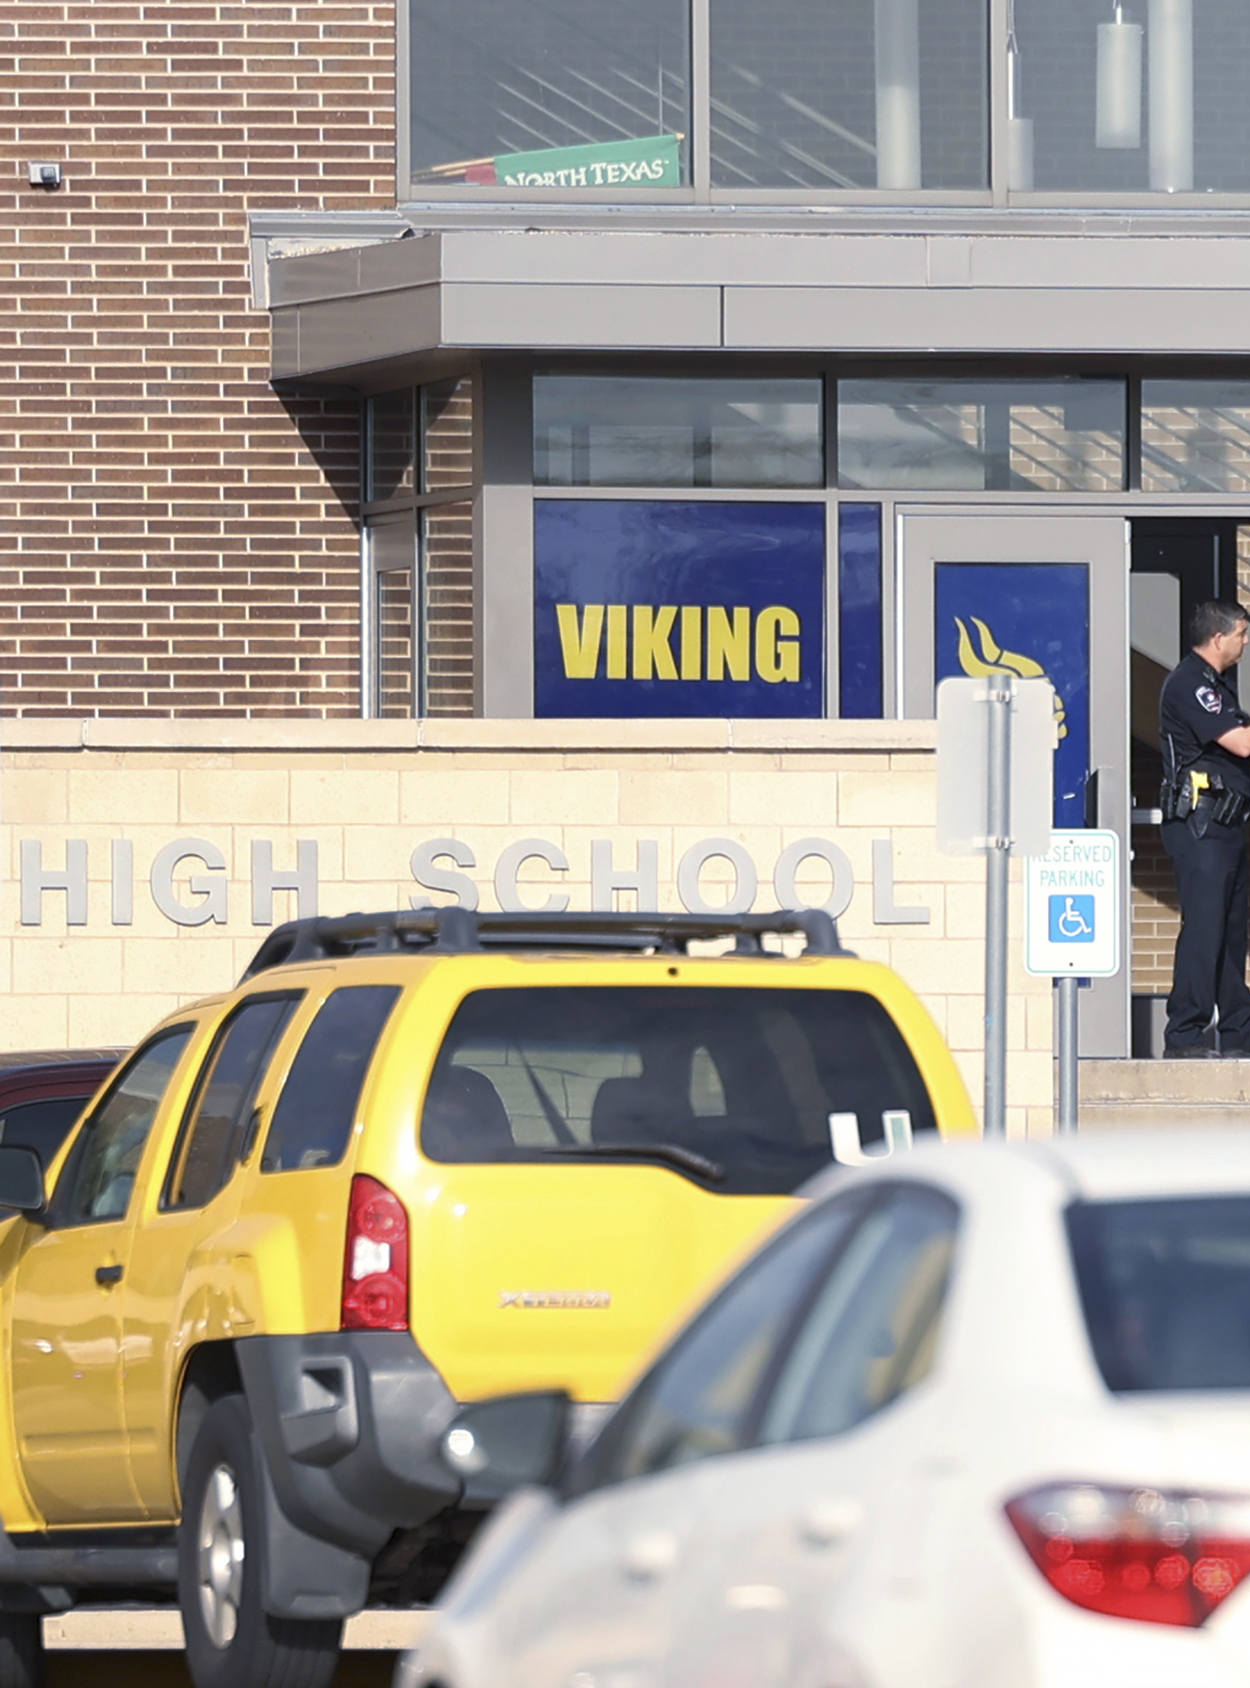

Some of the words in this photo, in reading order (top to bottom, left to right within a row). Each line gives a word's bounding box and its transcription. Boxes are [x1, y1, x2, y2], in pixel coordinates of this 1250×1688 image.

[505, 168, 587, 186] NORTH
[590, 159, 665, 185] TEXAS
[555, 604, 801, 684] VIKING
[20, 837, 319, 927] HIGH
[408, 837, 931, 925] SCHOOL
[1041, 871, 1104, 886] PARKING
